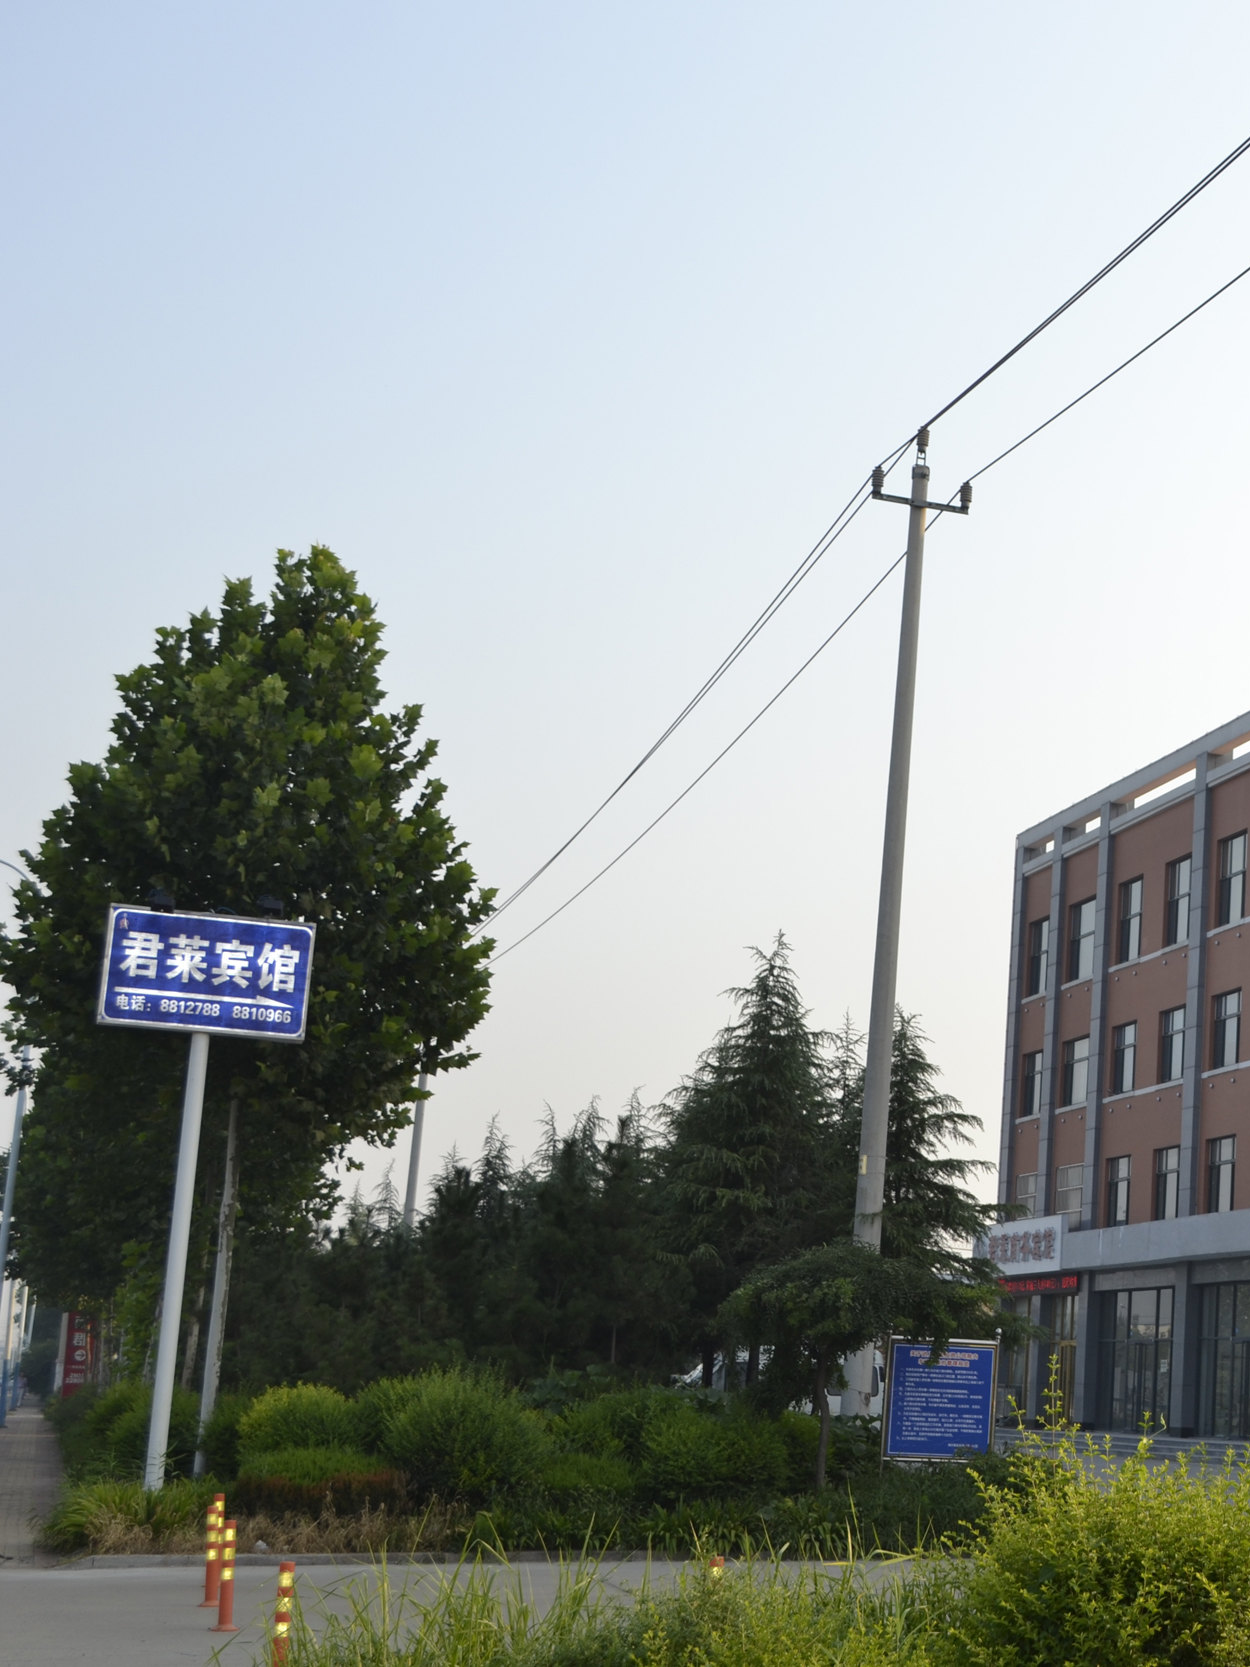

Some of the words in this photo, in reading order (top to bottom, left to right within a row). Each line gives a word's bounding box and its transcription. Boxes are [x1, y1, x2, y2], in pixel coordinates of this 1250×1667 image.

[119, 930, 300, 993] 君莱宾馆
[160, 999, 220, 1017] 8812788
[232, 1005, 292, 1024] 8810966
